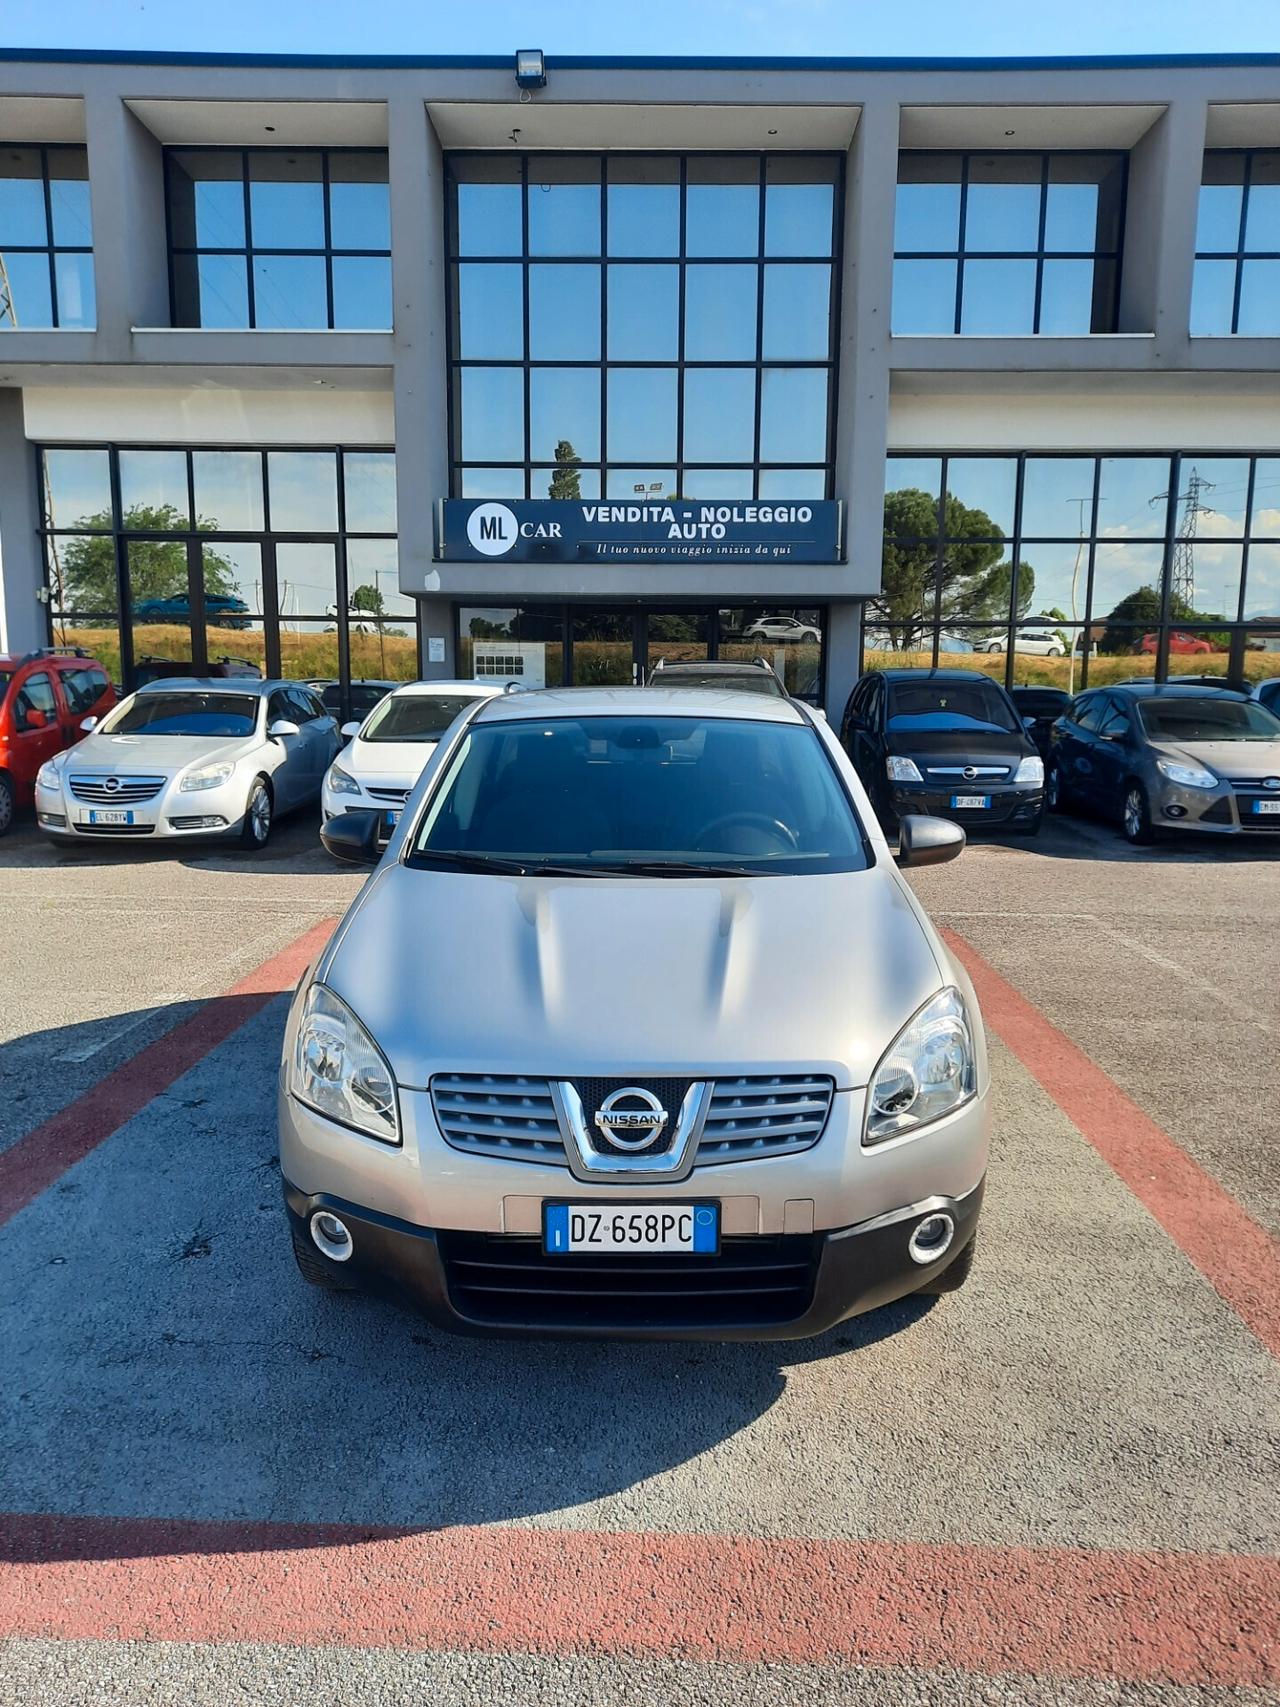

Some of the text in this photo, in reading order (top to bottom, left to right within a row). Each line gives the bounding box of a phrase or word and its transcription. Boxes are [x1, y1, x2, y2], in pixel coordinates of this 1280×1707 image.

[582, 506, 675, 523] VENDITA
[700, 506, 812, 523] NOLEGGIO
[480, 516, 562, 540] ML CAR
[667, 523, 726, 539] AUTO
[597, 543, 792, 557] Il tuo nuovo viaggio inizia da qui
[602, 1114, 661, 1125] NISSAN
